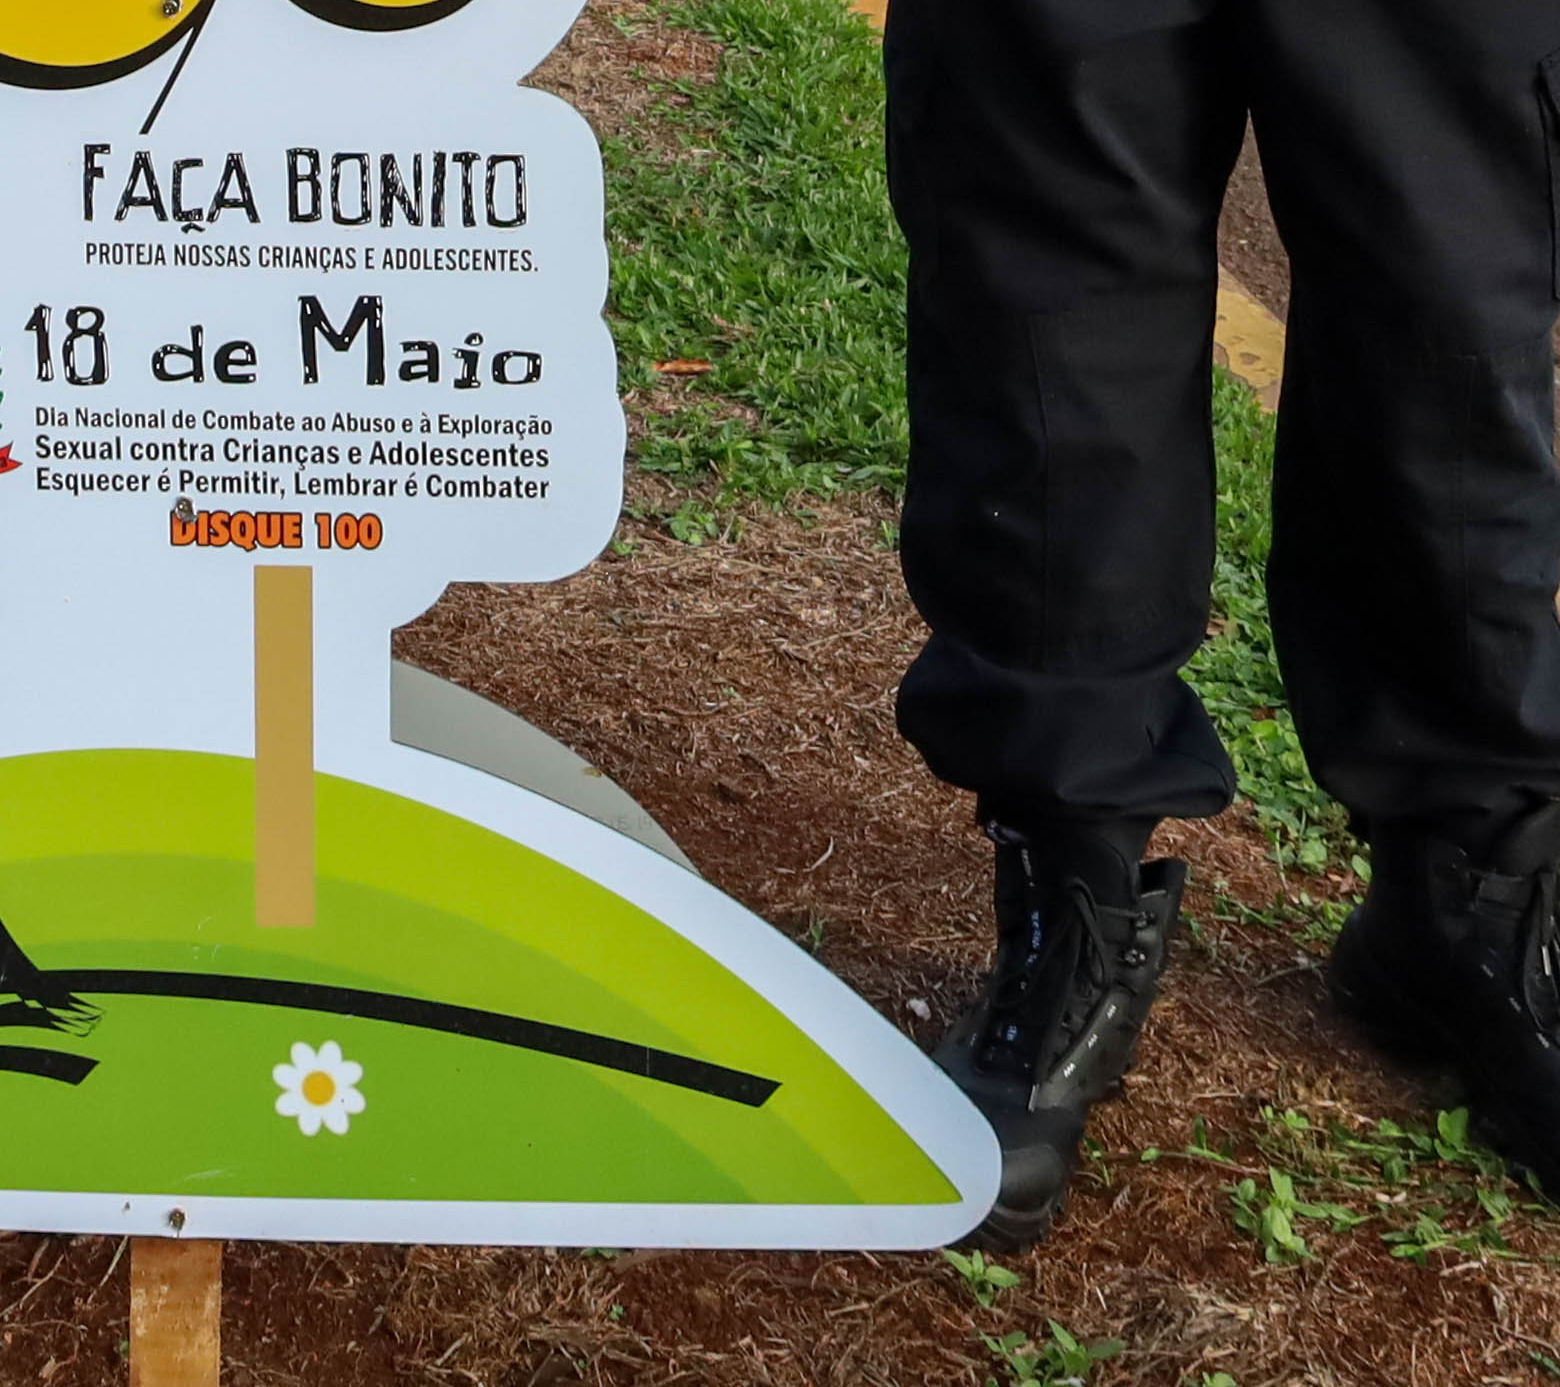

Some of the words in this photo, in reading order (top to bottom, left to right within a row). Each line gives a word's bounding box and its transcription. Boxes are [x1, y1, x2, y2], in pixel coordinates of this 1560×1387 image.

[84, 143, 261, 234] FAÇA
[286, 147, 527, 228] BONITO
[85, 243, 167, 267] PROTEJA
[174, 245, 251, 269] NOSSAS
[258, 245, 357, 275] CRIANÇAS
[364, 247, 375, 269] E
[382, 247, 539, 273] ADOLESCENTES.
[24, 303, 110, 386] 18
[151, 324, 257, 384] de
[297, 295, 542, 390] Maio
[35, 406, 68, 427] Dia
[75, 407, 166, 429] Nacional
[171, 409, 196, 430] de
[202, 409, 296, 431] Combate
[301, 416, 326, 432] ao
[331, 412, 395, 433] Abuso
[401, 418, 413, 433] e
[420, 411, 432, 434] à
[438, 414, 553, 440] Exploração
[35, 434, 122, 460] Sexual
[129, 437, 214, 462] contra
[222, 437, 340, 471] Crianças
[347, 448, 362, 465] e
[368, 441, 549, 468] Adolescentes
[36, 467, 151, 496] Esquecer
[157, 468, 171, 492] é
[179, 469, 286, 500] Permitir,
[294, 472, 398, 497] Lembrar
[404, 472, 418, 497] é
[425, 474, 550, 499] Combater
[170, 510, 303, 552] DISQUE
[314, 512, 383, 550] 100
